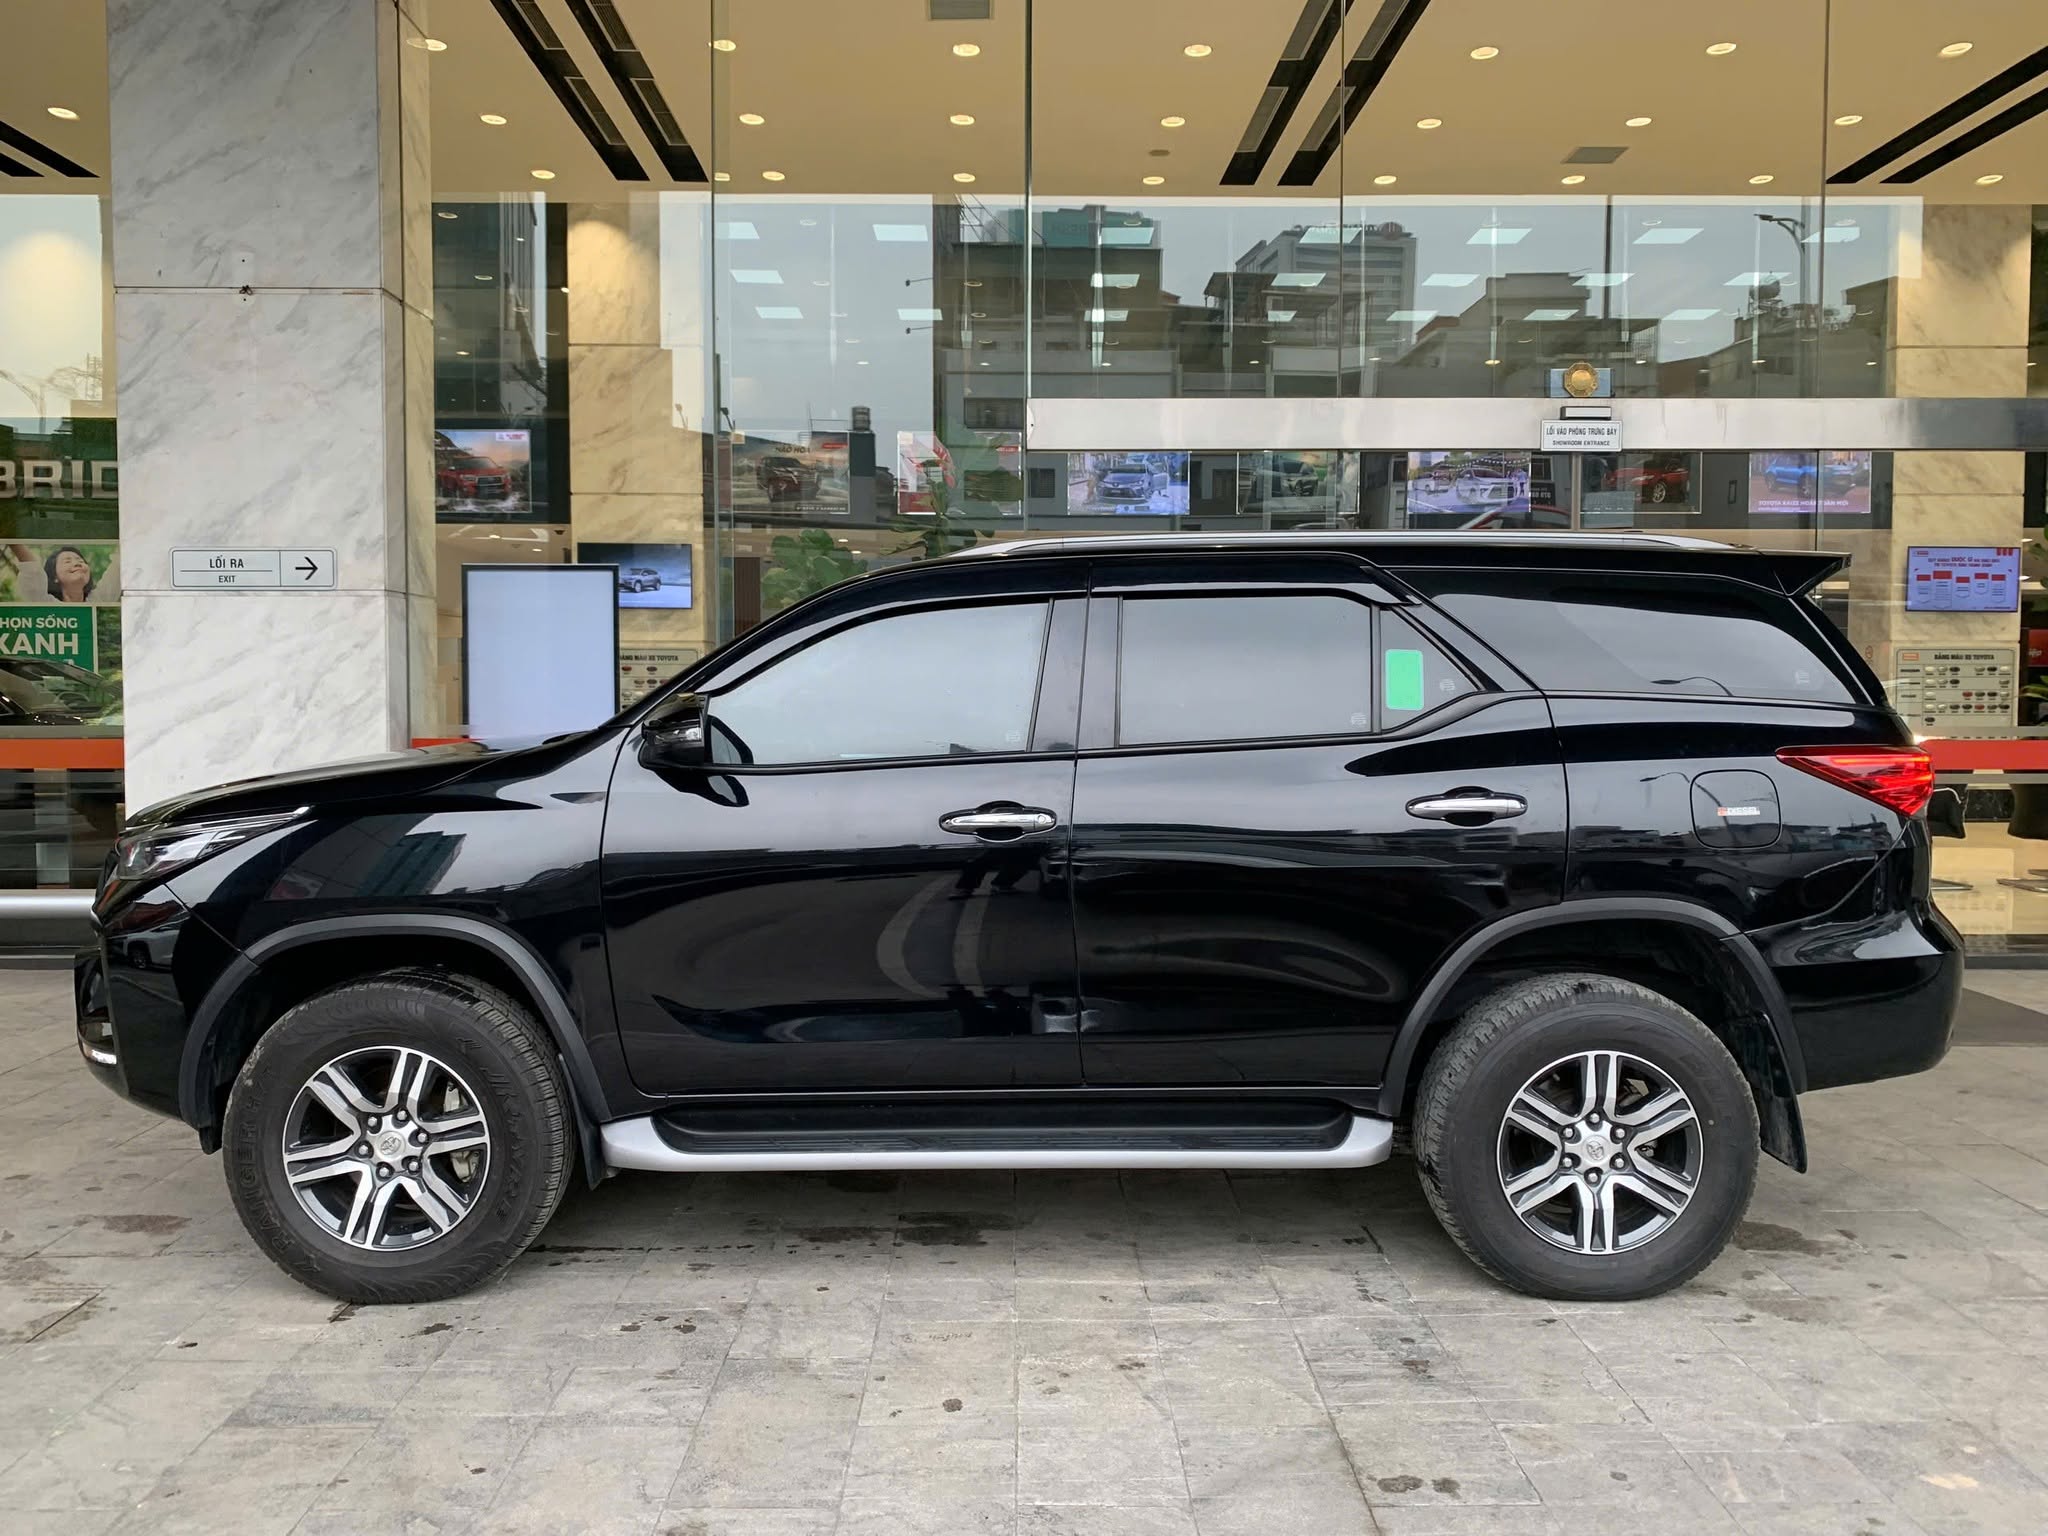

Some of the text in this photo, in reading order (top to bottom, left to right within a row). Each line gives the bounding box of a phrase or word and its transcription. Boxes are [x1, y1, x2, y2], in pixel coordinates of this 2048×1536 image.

[209, 554, 244, 569] LỐI RA
[218, 575, 236, 583] EXIT
[0, 613, 78, 632] HỌN SỐNG
